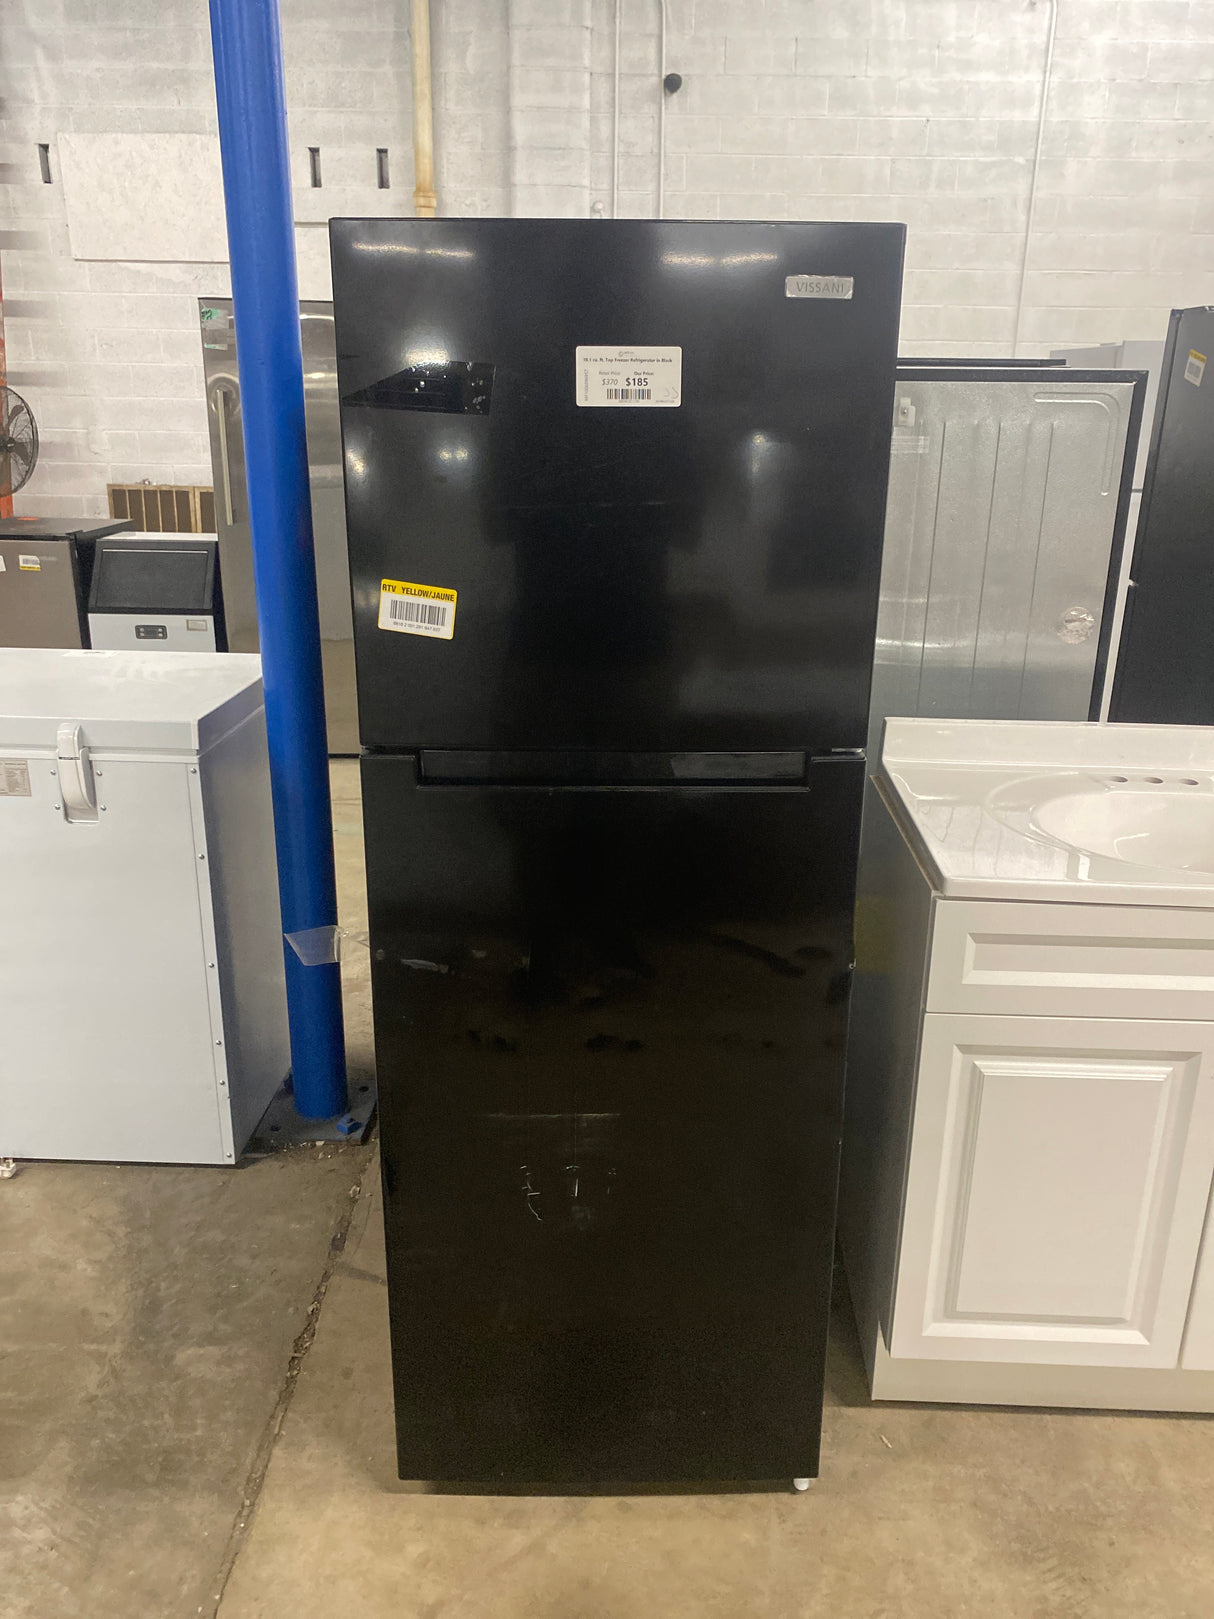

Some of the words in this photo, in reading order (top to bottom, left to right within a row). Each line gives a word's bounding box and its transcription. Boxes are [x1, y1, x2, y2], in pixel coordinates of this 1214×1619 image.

[796, 281, 844, 293] VISSANI
[602, 378, 619, 386] $370
[625, 377, 649, 387] $185
[382, 583, 397, 593] RTV
[401, 586, 455, 602] YELLOW/JAUNE
